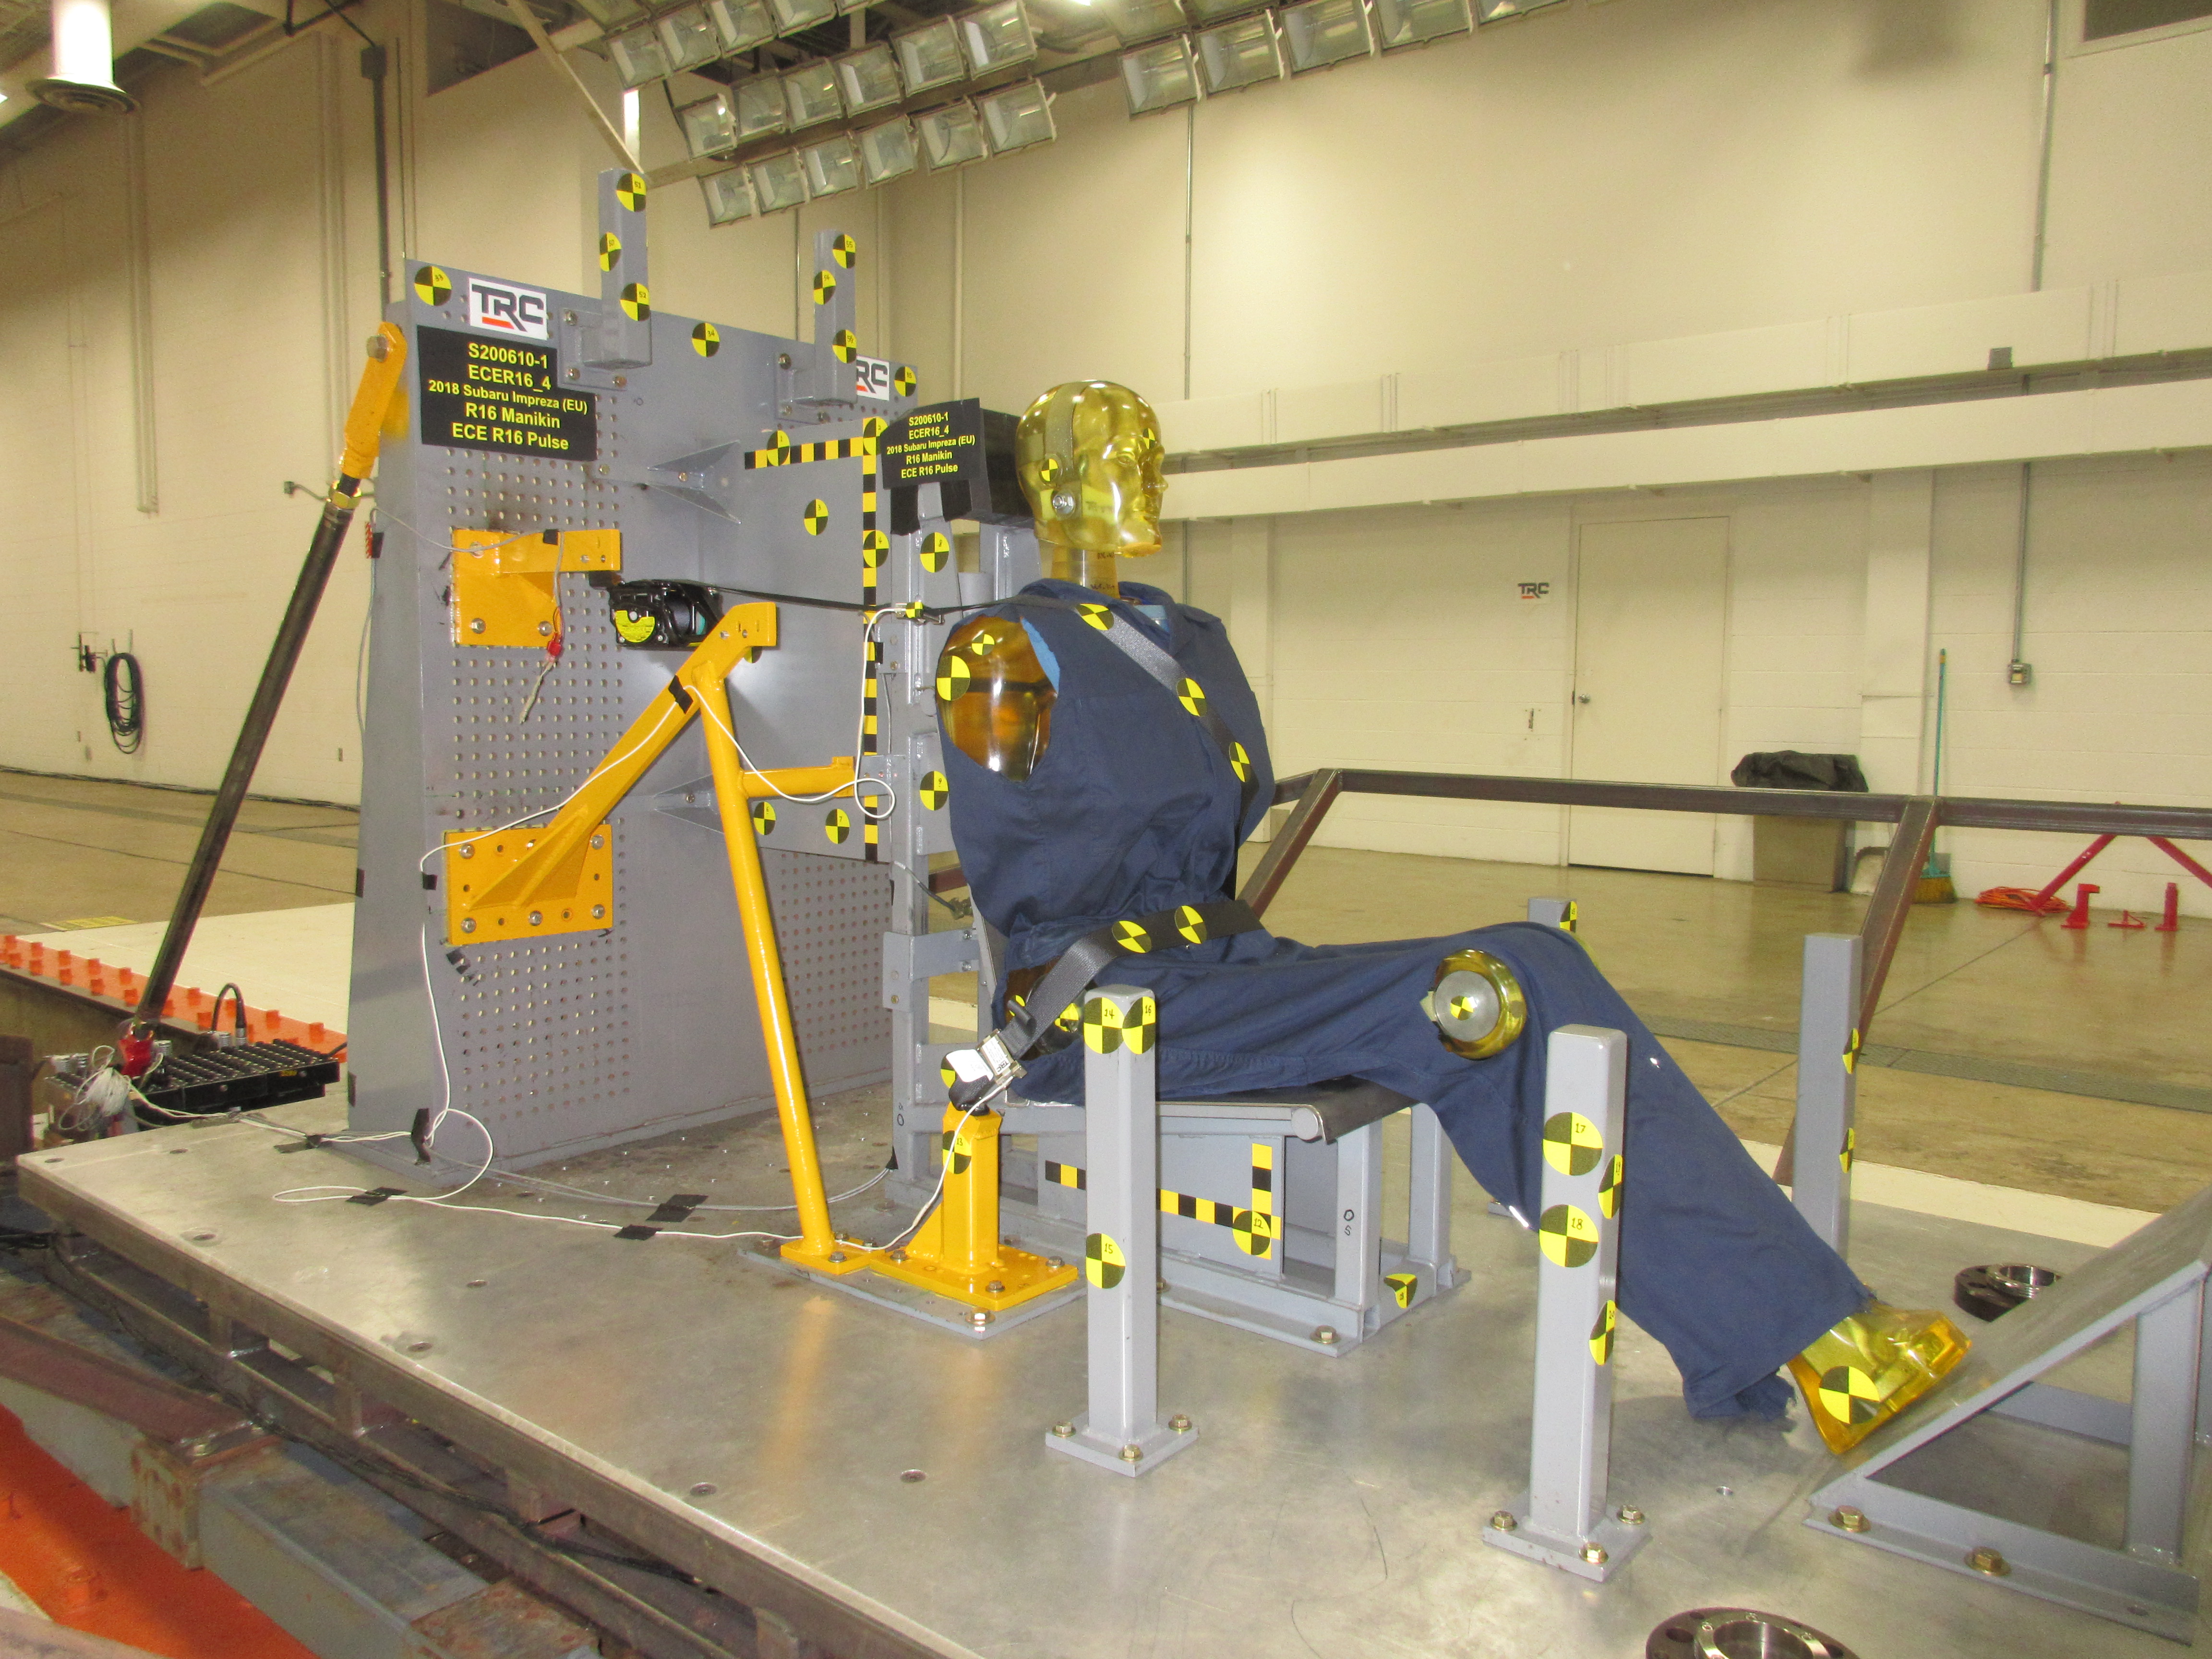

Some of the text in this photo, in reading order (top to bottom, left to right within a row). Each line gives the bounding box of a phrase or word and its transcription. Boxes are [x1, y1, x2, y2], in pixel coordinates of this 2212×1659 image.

[471, 284, 544, 332] TRC
[468, 342, 547, 369] S200610-1
[468, 364, 552, 393] ECER16_4
[857, 360, 888, 393] RC
[428, 379, 588, 415] 2018 Subaru Impreza (EU)
[466, 402, 560, 429] R16 Manikin
[909, 412, 949, 426] S200610-1
[452, 422, 569, 450] ECE R16 Pulse
[909, 425, 950, 440] ECER16_4
[887, 435, 975, 455] 2018 Subaru Impreza (EU)
[906, 450, 952, 465] R16 Manikin
[901, 463, 959, 479] ECE R16 Pulse
[1518, 582, 1550, 599] TRC
[1104, 1009, 1115, 1020] 14
[1145, 1005, 1152, 1014] 16
[996, 1060, 1009, 1072] TRC
[1575, 1123, 1586, 1133] 17
[1253, 1218, 1263, 1229] 12
[1571, 1218, 1583, 1230] 18
[1104, 1243, 1113, 1254] 15
